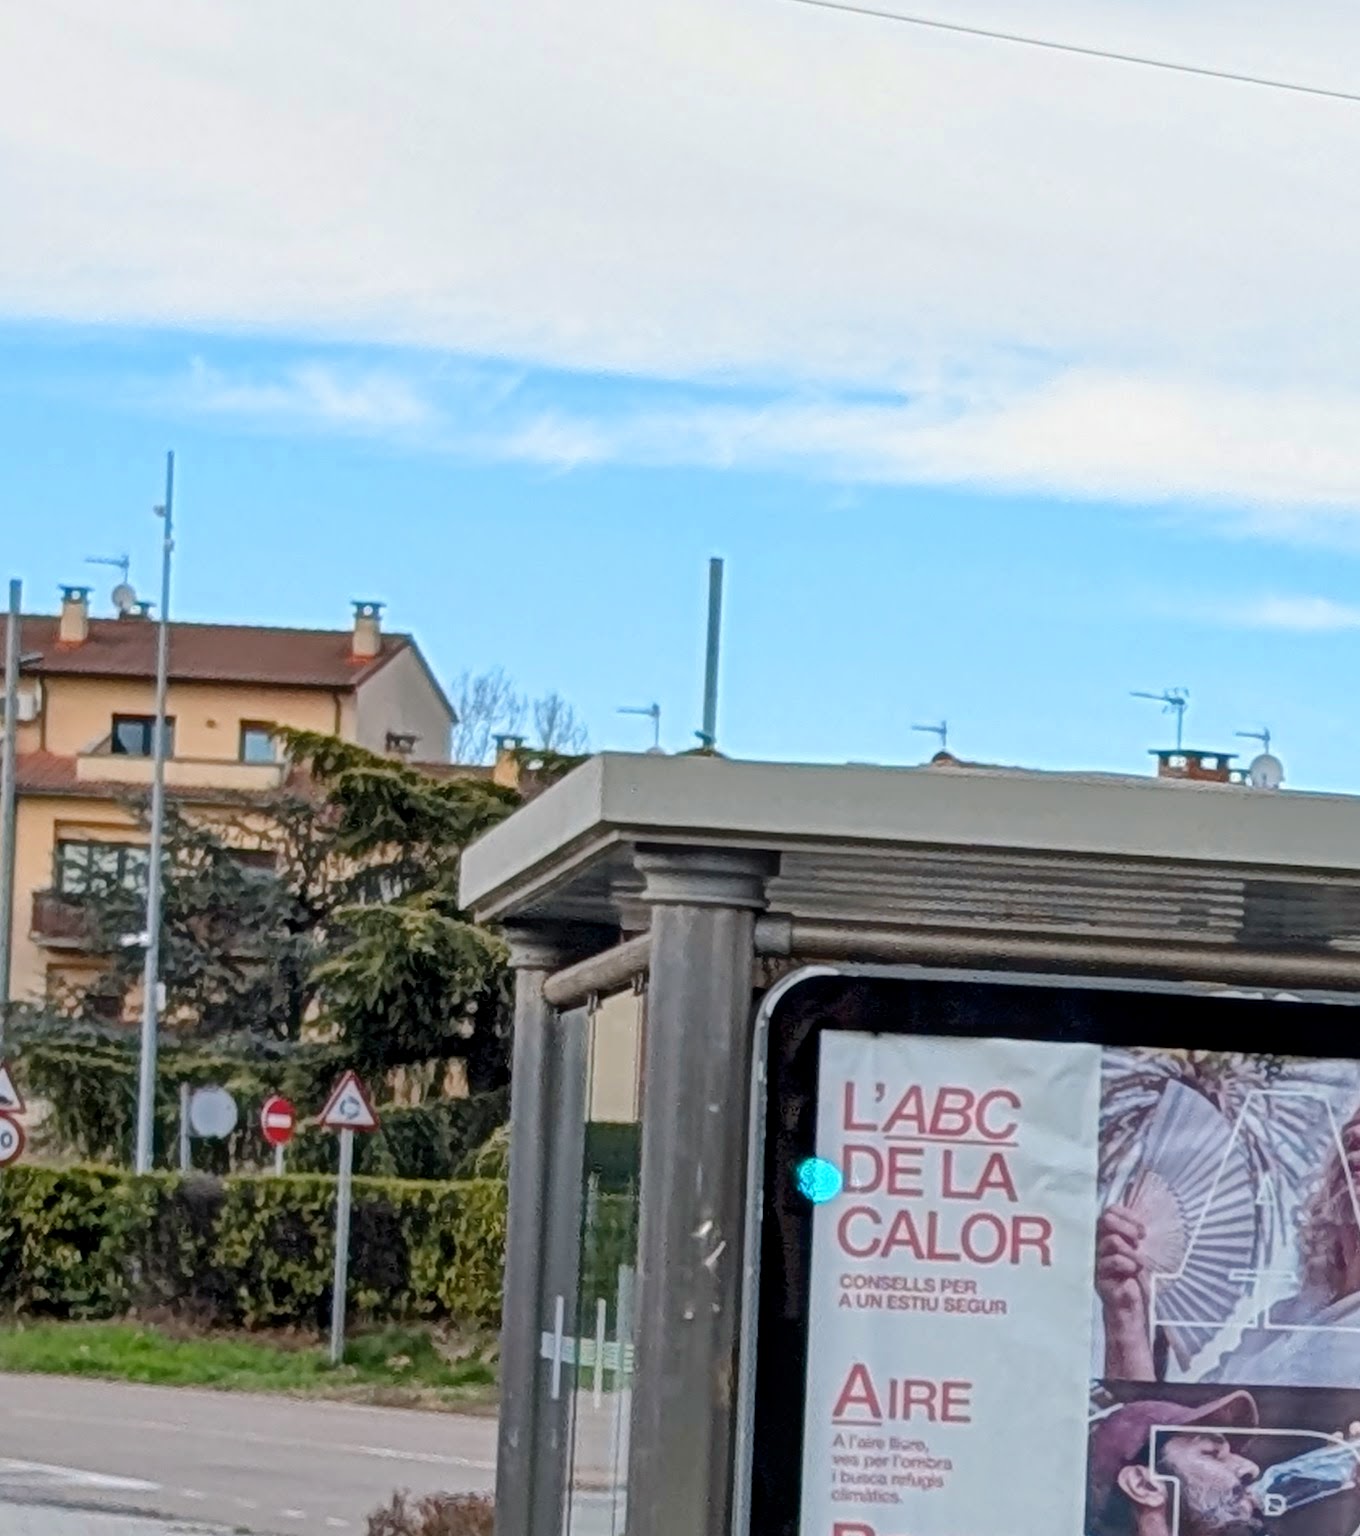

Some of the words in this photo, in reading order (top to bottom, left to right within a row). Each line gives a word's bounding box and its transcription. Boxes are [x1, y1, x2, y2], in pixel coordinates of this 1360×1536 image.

[842, 1144, 924, 1197] DE
[942, 1149, 1018, 1202] LA
[837, 1205, 1053, 1267] CALOR
[838, 1292, 851, 1308] A
[855, 1293, 883, 1310] UN
[887, 1294, 939, 1312] ESTIU
[943, 1298, 1007, 1314] SEGUR
[839, 1273, 936, 1294] CONSELLS
[940, 1279, 977, 1295] PER
